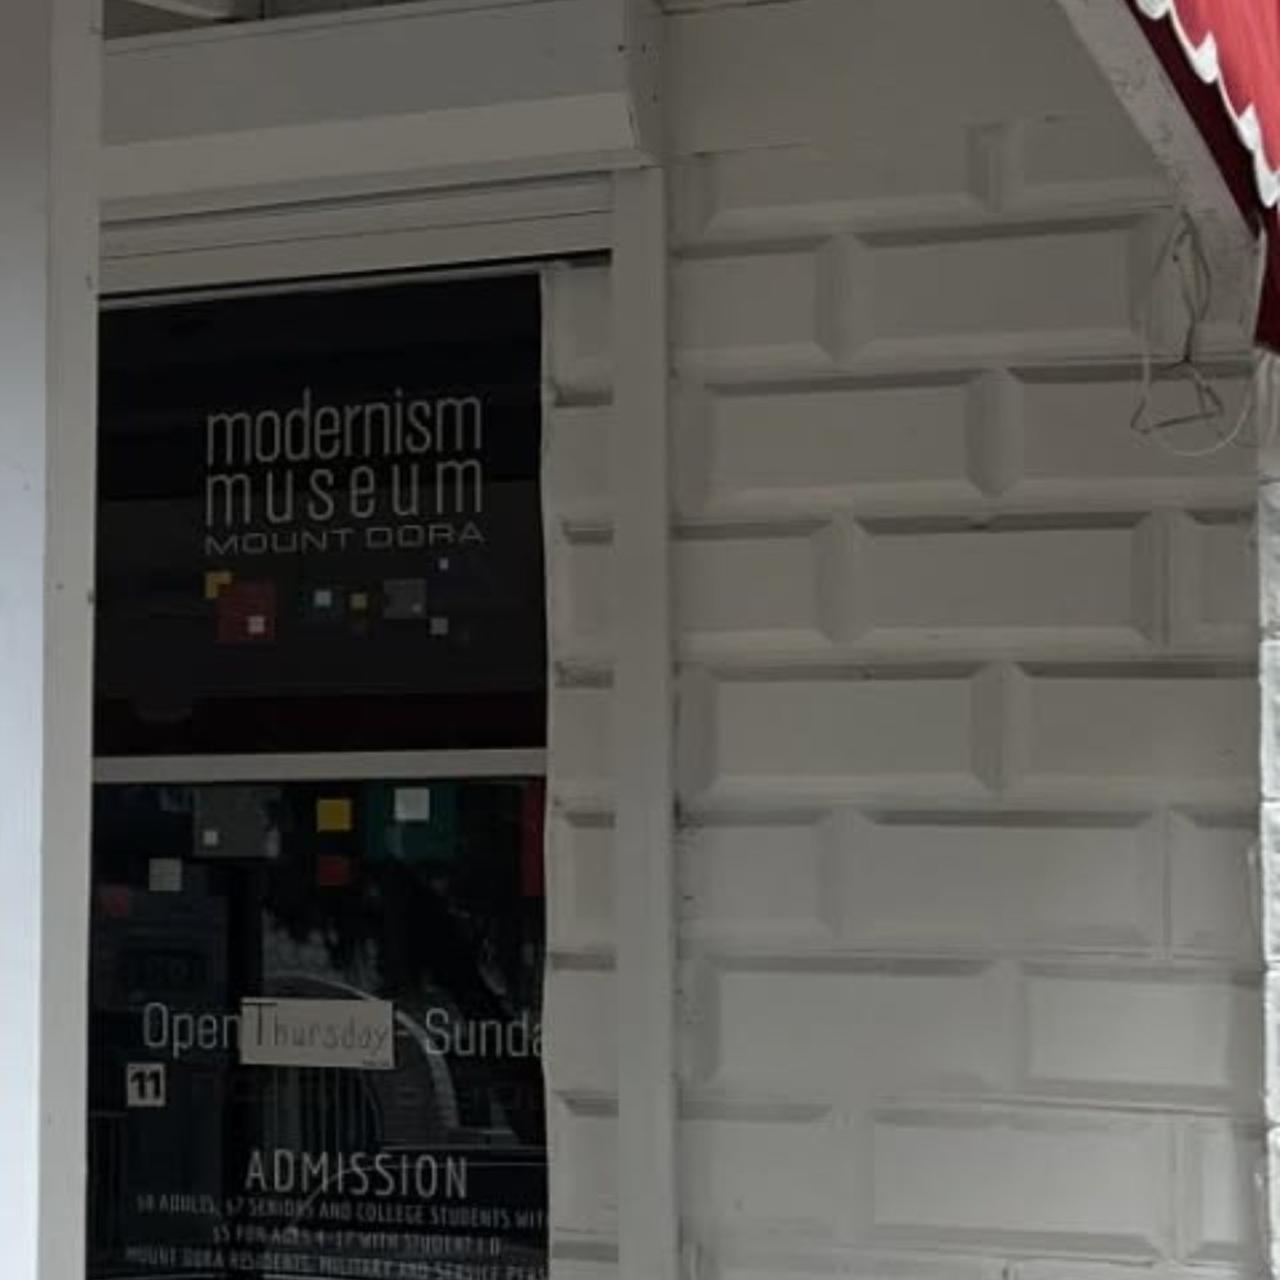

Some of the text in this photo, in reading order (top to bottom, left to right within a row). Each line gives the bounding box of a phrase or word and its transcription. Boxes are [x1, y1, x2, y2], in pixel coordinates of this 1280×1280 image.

[205, 385, 483, 467] modernism
[205, 458, 483, 527] museum
[204, 521, 486, 556] MOUNT DORA
[242, 1002, 389, 1056] Thursday
[130, 1070, 162, 1100] 11
[244, 1148, 469, 1199] ADMISSION
[355, 1202, 424, 1224] COLLEGE
[430, 1205, 511, 1230] STUDENTS
